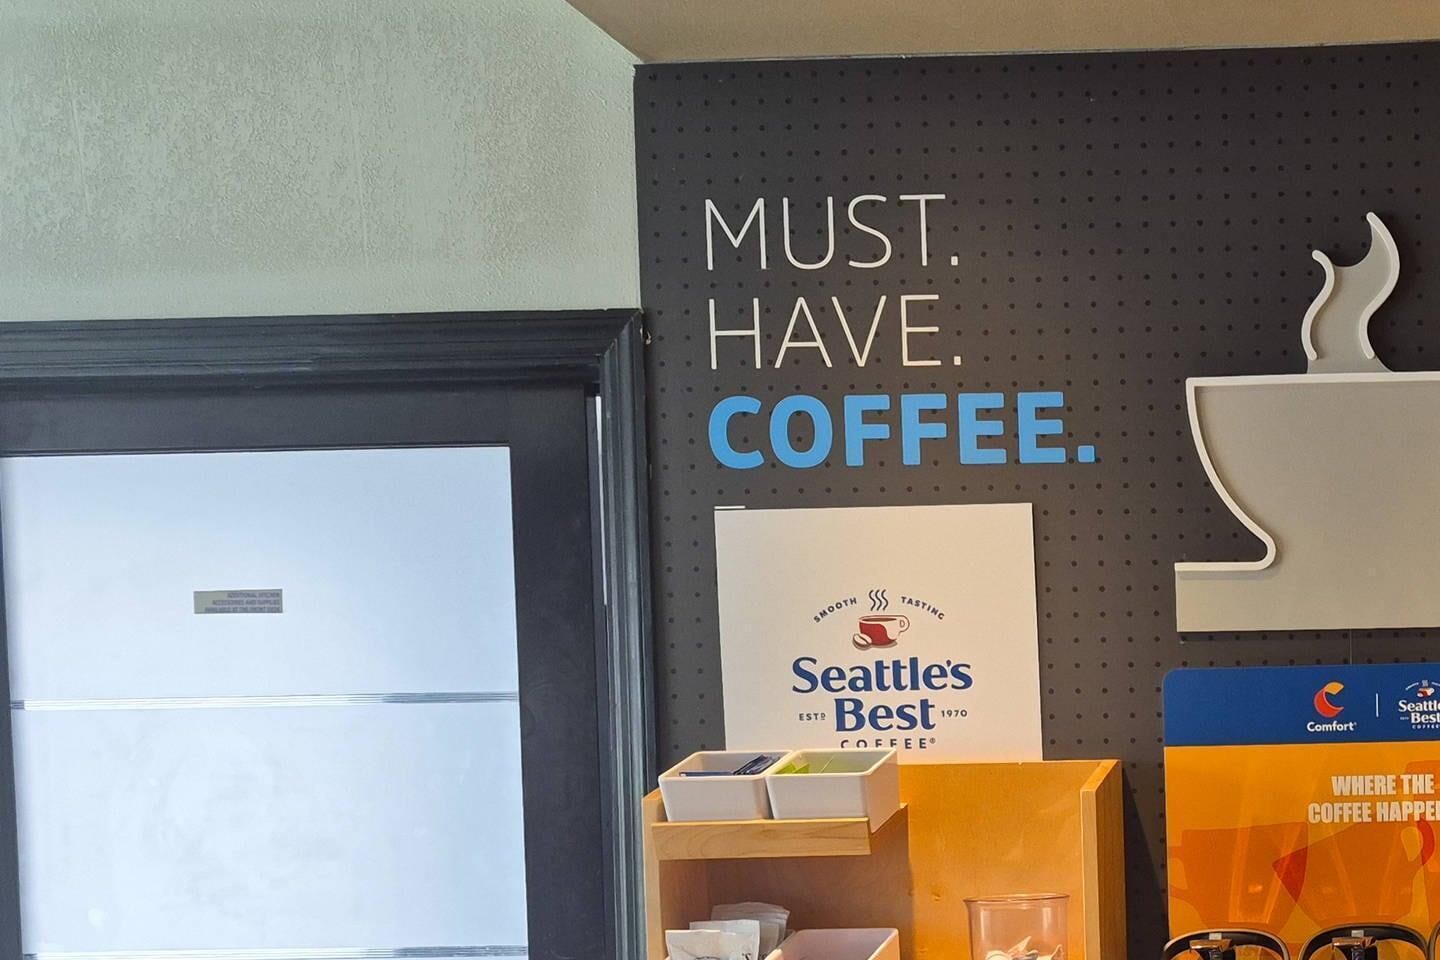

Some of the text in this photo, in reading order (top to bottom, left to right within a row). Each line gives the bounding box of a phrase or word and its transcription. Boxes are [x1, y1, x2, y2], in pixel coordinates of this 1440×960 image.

[705, 194, 959, 271] MUST.
[708, 294, 962, 369] HAVE.
[708, 391, 1096, 468] COFFEE.
[813, 597, 857, 623] SMOOTH
[900, 596, 945, 620] TASTING
[792, 656, 973, 693] Seattle's
[834, 698, 936, 732] Best
[941, 709, 968, 718] 1970
[1331, 774, 1434, 796] WHERE THE
[1308, 802, 1371, 823] COFFEE
